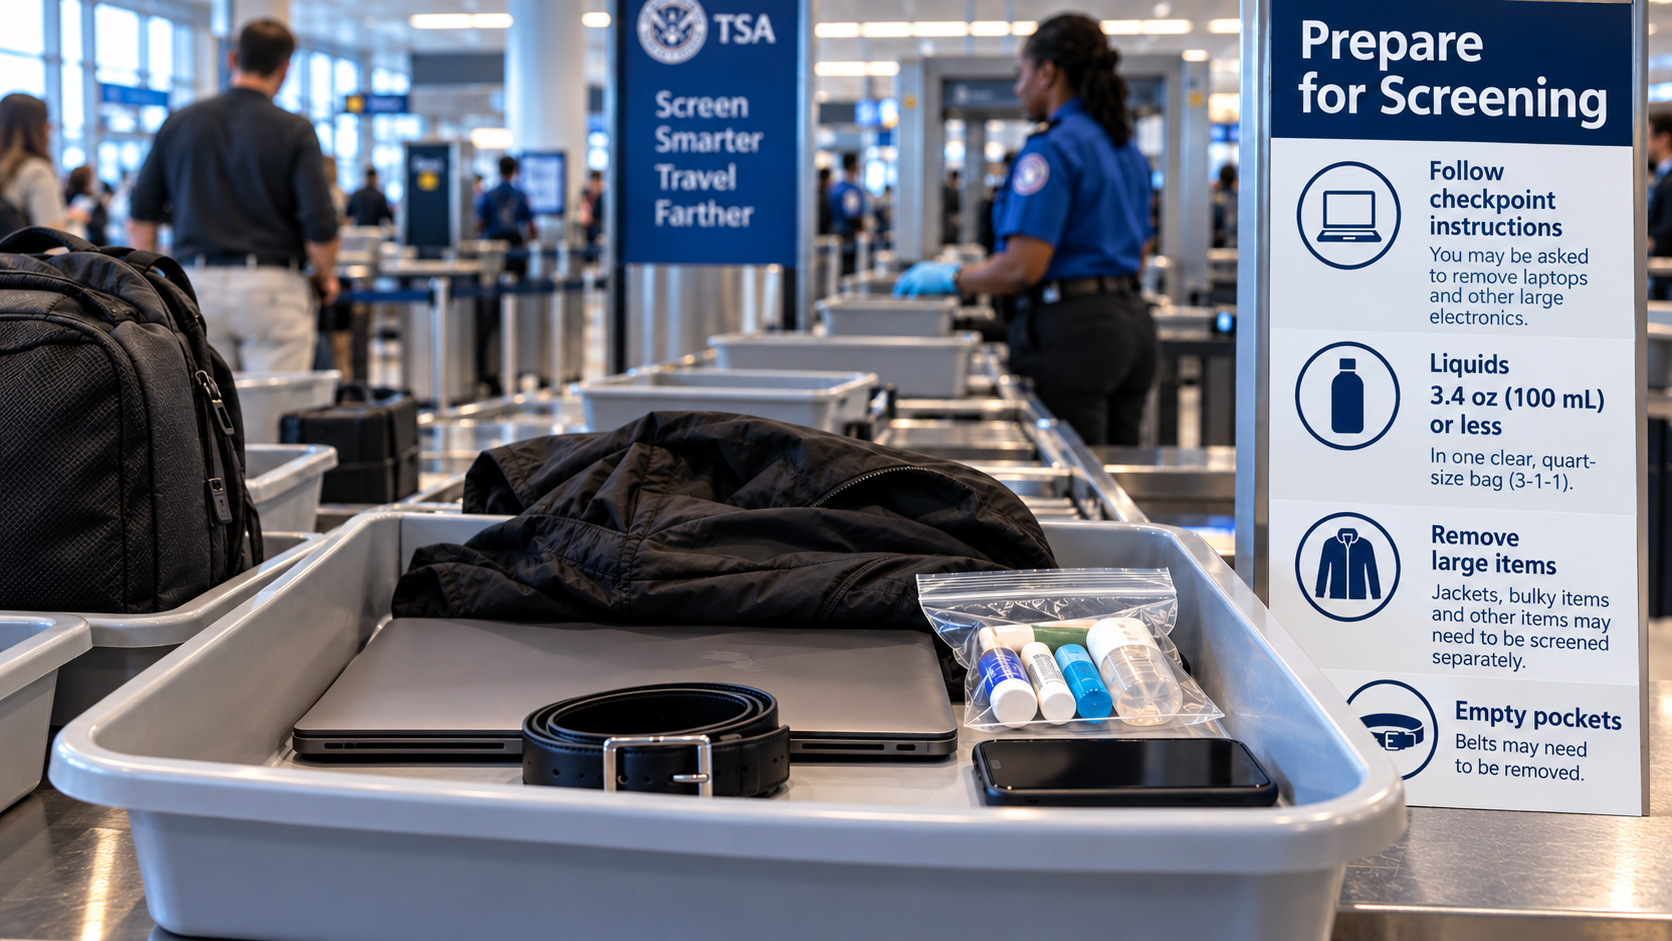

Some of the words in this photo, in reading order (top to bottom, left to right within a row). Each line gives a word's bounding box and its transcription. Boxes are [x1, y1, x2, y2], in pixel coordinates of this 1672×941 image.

[713, 13, 776, 44] TSA
[1302, 19, 1484, 72] Prepare
[655, 90, 749, 119] Screen
[1298, 70, 1366, 114] for
[1380, 74, 1607, 130] Screening
[655, 125, 763, 153] Smarter
[654, 162, 736, 191] Travel
[1430, 159, 1505, 181] Follow
[655, 199, 754, 227] Farther
[1429, 187, 1557, 215] checkpoint
[1430, 214, 1563, 237] instructions
[1429, 246, 1462, 263] You
[1468, 250, 1505, 267] may
[1510, 246, 1532, 264] be
[1537, 247, 1589, 265] asked
[1429, 268, 1447, 284] to
[1453, 271, 1518, 285] remove
[1523, 268, 1588, 290] laptops
[1429, 286, 1462, 304] and
[1468, 287, 1515, 305] other
[1520, 287, 1564, 309] large
[1429, 307, 1528, 326] electronics.
[1430, 352, 1510, 378] Liquids
[1430, 385, 1466, 406] 3.4
[1471, 391, 1498, 407] oz
[1504, 386, 1556, 411] (100
[1563, 388, 1605, 414] mL)
[1430, 418, 1454, 434] or
[1461, 413, 1503, 436] less
[1431, 446, 1446, 464] In
[1452, 452, 1485, 465] one
[1490, 448, 1536, 470] clear,
[1542, 454, 1596, 472] quart-
[1430, 469, 1464, 486] size
[1470, 469, 1503, 492] bag
[1509, 471, 1573, 493] (3-1-1).
[1432, 524, 1520, 548] Remove
[1432, 549, 1489, 577] large
[1495, 552, 1557, 576] items
[1431, 583, 1503, 606] Jackets,
[1509, 586, 1557, 609] bulky
[1562, 589, 1610, 608] items
[1431, 605, 1464, 623] and
[1469, 607, 1516, 625] other
[1521, 609, 1569, 628] items
[1574, 616, 1612, 634] may
[1432, 627, 1475, 645] need
[1479, 630, 1498, 646] to
[1503, 629, 1525, 648] be
[1530, 634, 1609, 652] screened
[1432, 651, 1526, 671] separately.
[1455, 700, 1527, 730] Empty
[1533, 706, 1622, 731] pockets
[1456, 733, 1497, 752] Belts
[1502, 740, 1540, 758] may
[1544, 740, 1587, 758] need
[1454, 758, 1473, 774] to
[1478, 757, 1500, 776] be
[1504, 764, 1585, 782] removed.
